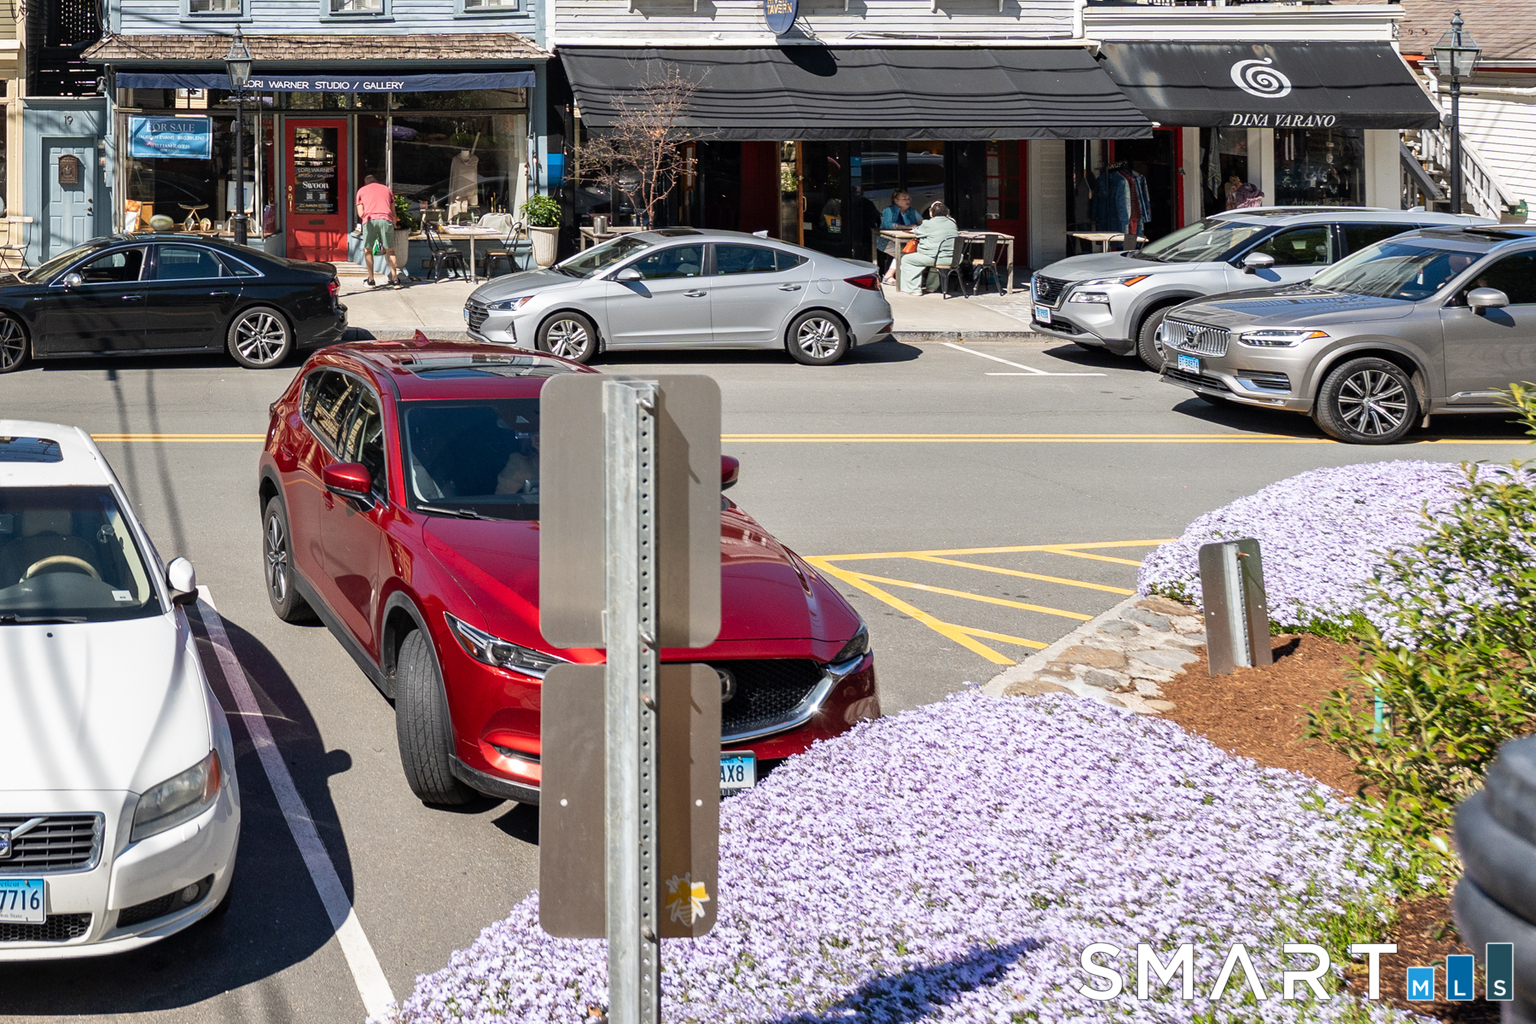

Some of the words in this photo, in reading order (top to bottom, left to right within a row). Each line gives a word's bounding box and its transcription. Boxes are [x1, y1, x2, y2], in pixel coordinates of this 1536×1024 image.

[767, 3, 792, 14] TAVERN
[269, 80, 309, 89] WARNER
[315, 81, 350, 90] STUDIO
[363, 81, 404, 90] GALLERY
[64, 115, 74, 126] 19
[1230, 113, 1269, 126] DINA
[1274, 114, 1336, 127] VARANO
[146, 122, 167, 133] FOR
[169, 123, 195, 133] SALE
[302, 181, 330, 189] Swoon
